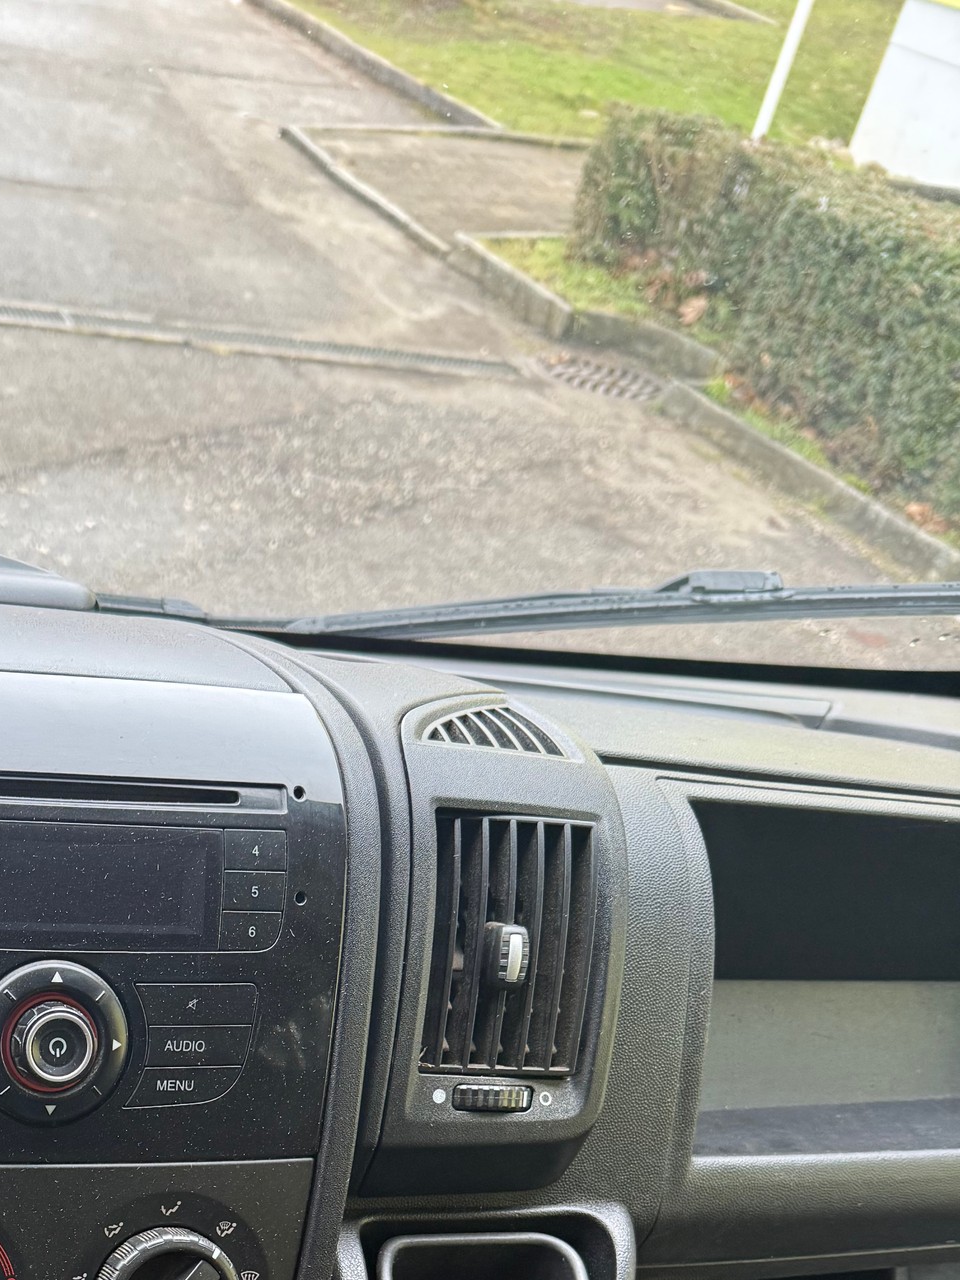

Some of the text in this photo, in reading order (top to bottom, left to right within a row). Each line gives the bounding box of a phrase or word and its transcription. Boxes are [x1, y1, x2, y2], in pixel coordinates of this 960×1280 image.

[252, 845, 260, 857] 4
[251, 886, 259, 898] 5
[248, 926, 256, 938] 6
[164, 1040, 205, 1052] AUDIO
[156, 1080, 194, 1091] MENU
